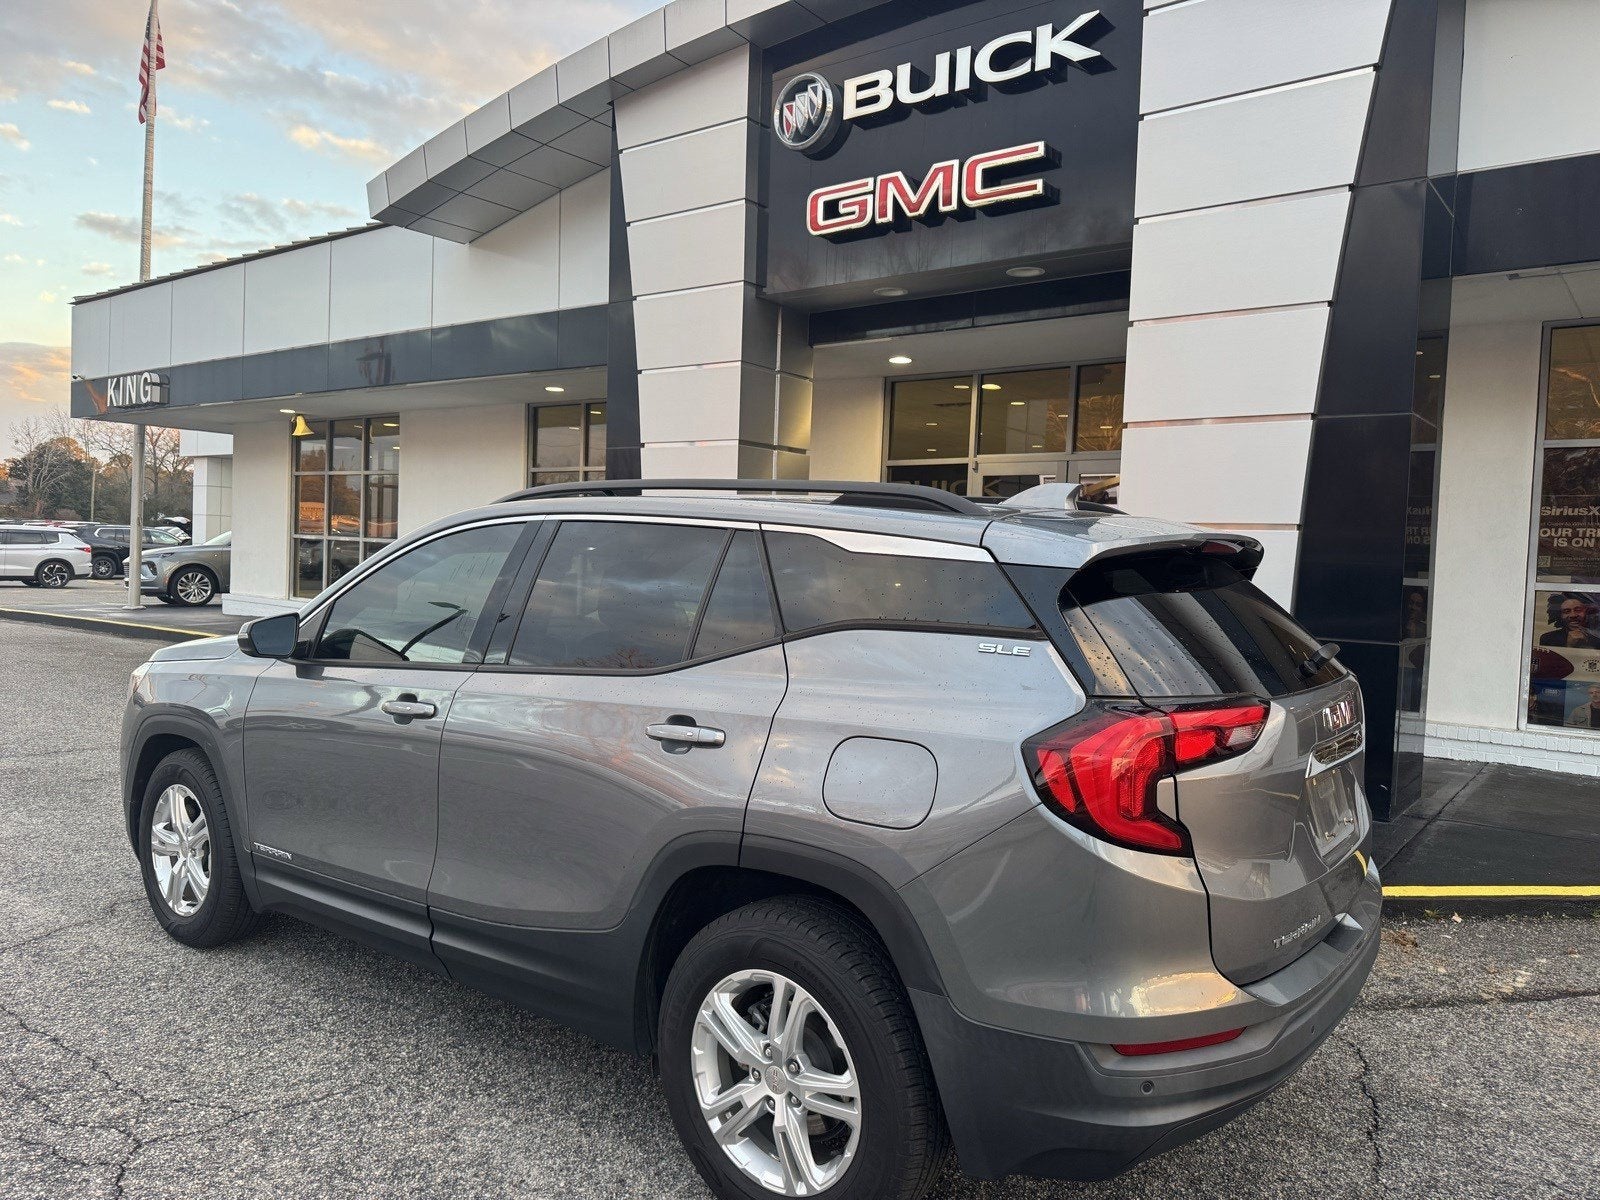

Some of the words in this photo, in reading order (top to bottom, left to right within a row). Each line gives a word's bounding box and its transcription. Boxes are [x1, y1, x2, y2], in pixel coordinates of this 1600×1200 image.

[843, 9, 1101, 120] BUICK
[806, 141, 1045, 236] GMC
[107, 371, 151, 407] KING
[1553, 537, 1568, 547] IS
[1571, 537, 1596, 547] ON
[978, 643, 1031, 657] SLE
